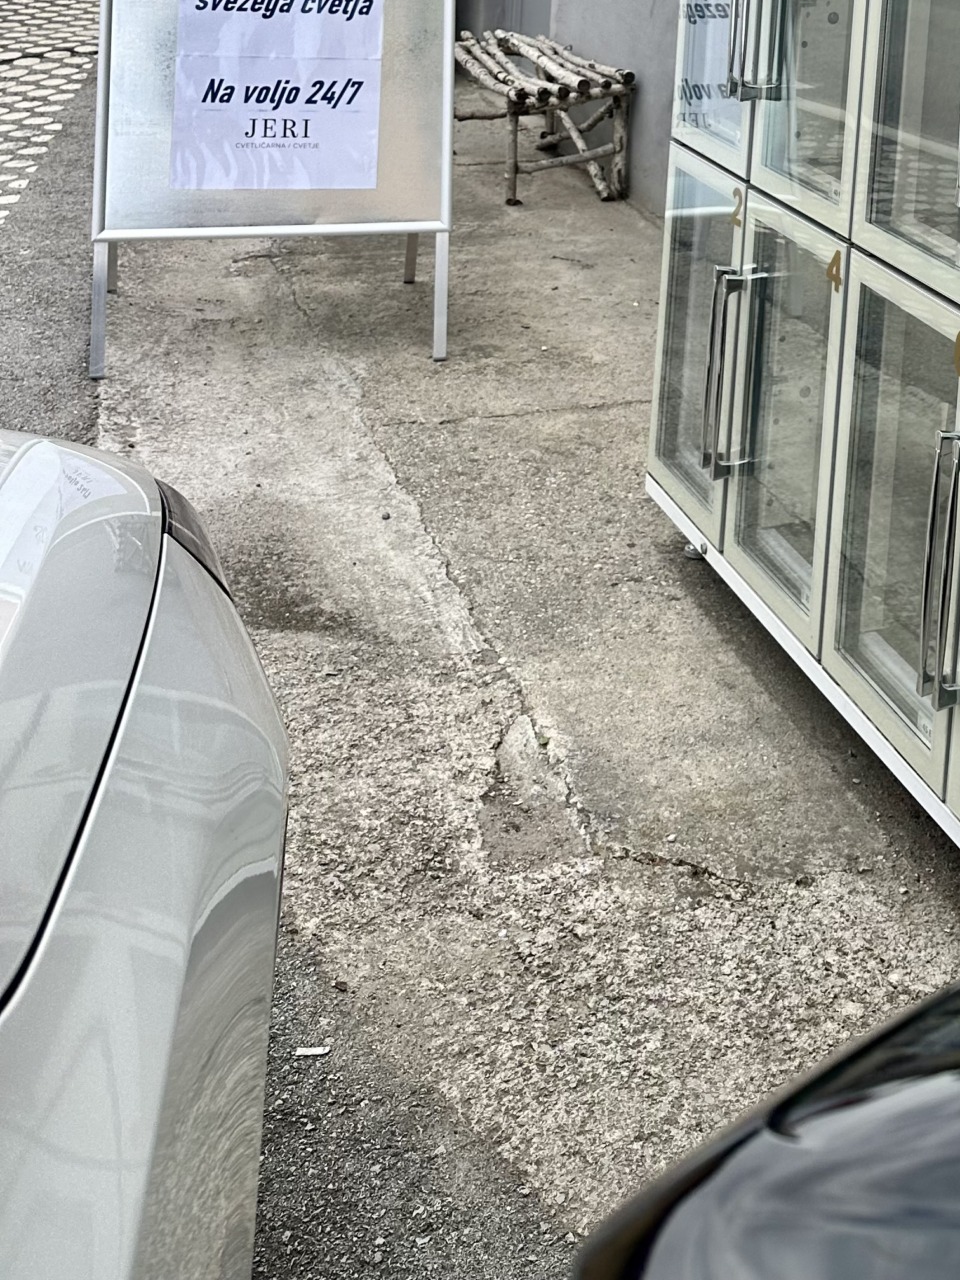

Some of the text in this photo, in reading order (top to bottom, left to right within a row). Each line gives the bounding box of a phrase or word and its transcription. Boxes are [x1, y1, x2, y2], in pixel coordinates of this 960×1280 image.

[201, 77, 365, 112] Na voljo 24/7
[235, 141, 286, 150] CVETLIČARNA
[244, 117, 311, 139] JERI
[730, 186, 744, 228] 2
[825, 248, 843, 294] 4
